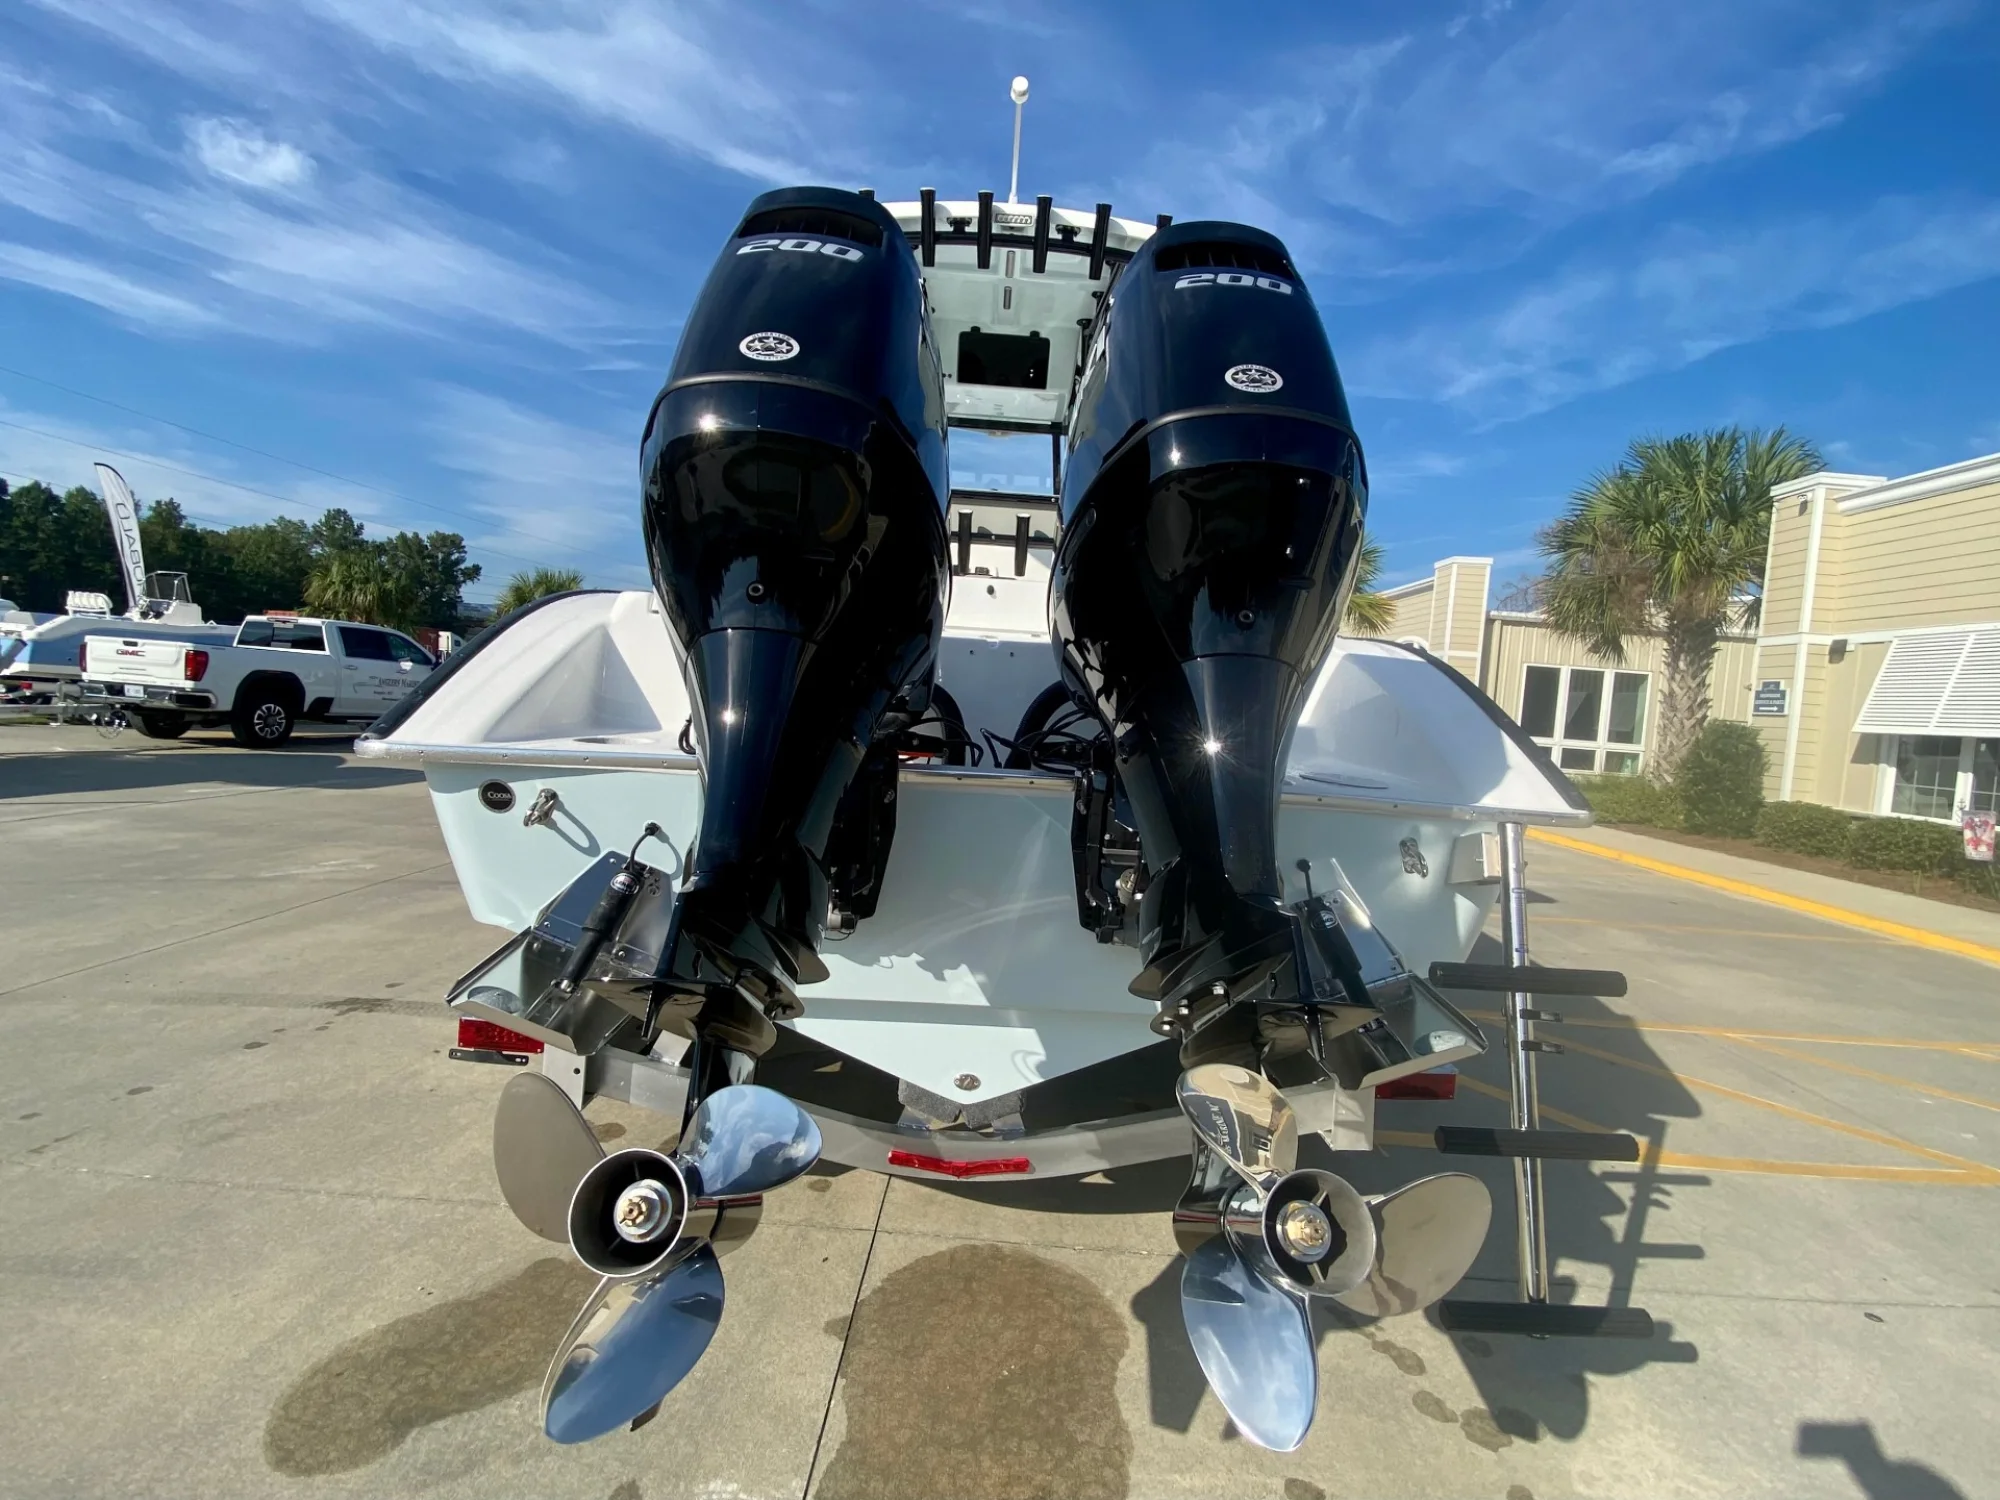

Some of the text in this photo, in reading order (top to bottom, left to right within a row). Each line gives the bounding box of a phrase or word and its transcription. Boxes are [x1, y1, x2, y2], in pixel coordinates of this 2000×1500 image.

[736, 238, 864, 263] 200
[1174, 272, 1293, 295] 200
[116, 648, 146, 657] GMC
